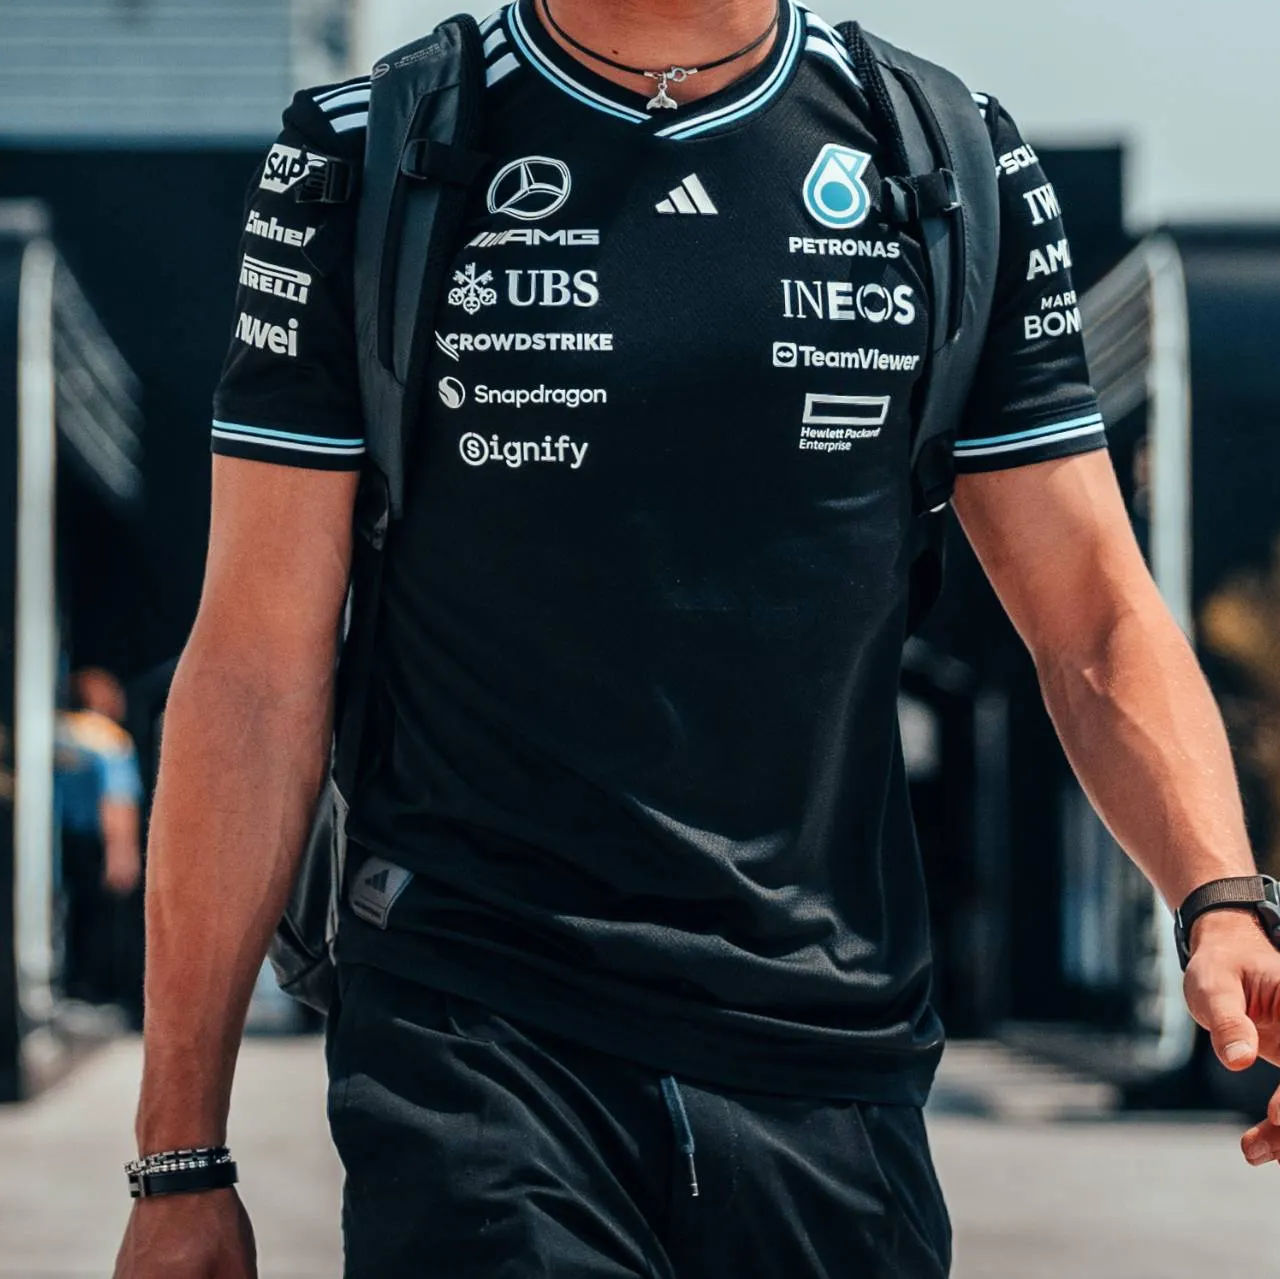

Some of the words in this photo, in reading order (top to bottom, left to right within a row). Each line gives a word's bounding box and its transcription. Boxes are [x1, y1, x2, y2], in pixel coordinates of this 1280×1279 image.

[264, 151, 307, 186] SAP
[492, 229, 600, 246] AMG
[788, 236, 901, 259] PETRONAS
[505, 269, 600, 308] UBS
[780, 278, 916, 326] INEOS
[442, 332, 614, 353] CROWDSTRIKE
[798, 345, 920, 371] TeamViewer
[474, 384, 608, 409] Snapdragon
[800, 426, 845, 439] Hewlett
[844, 427, 881, 439] Packard
[798, 438, 852, 453] Enterprise
